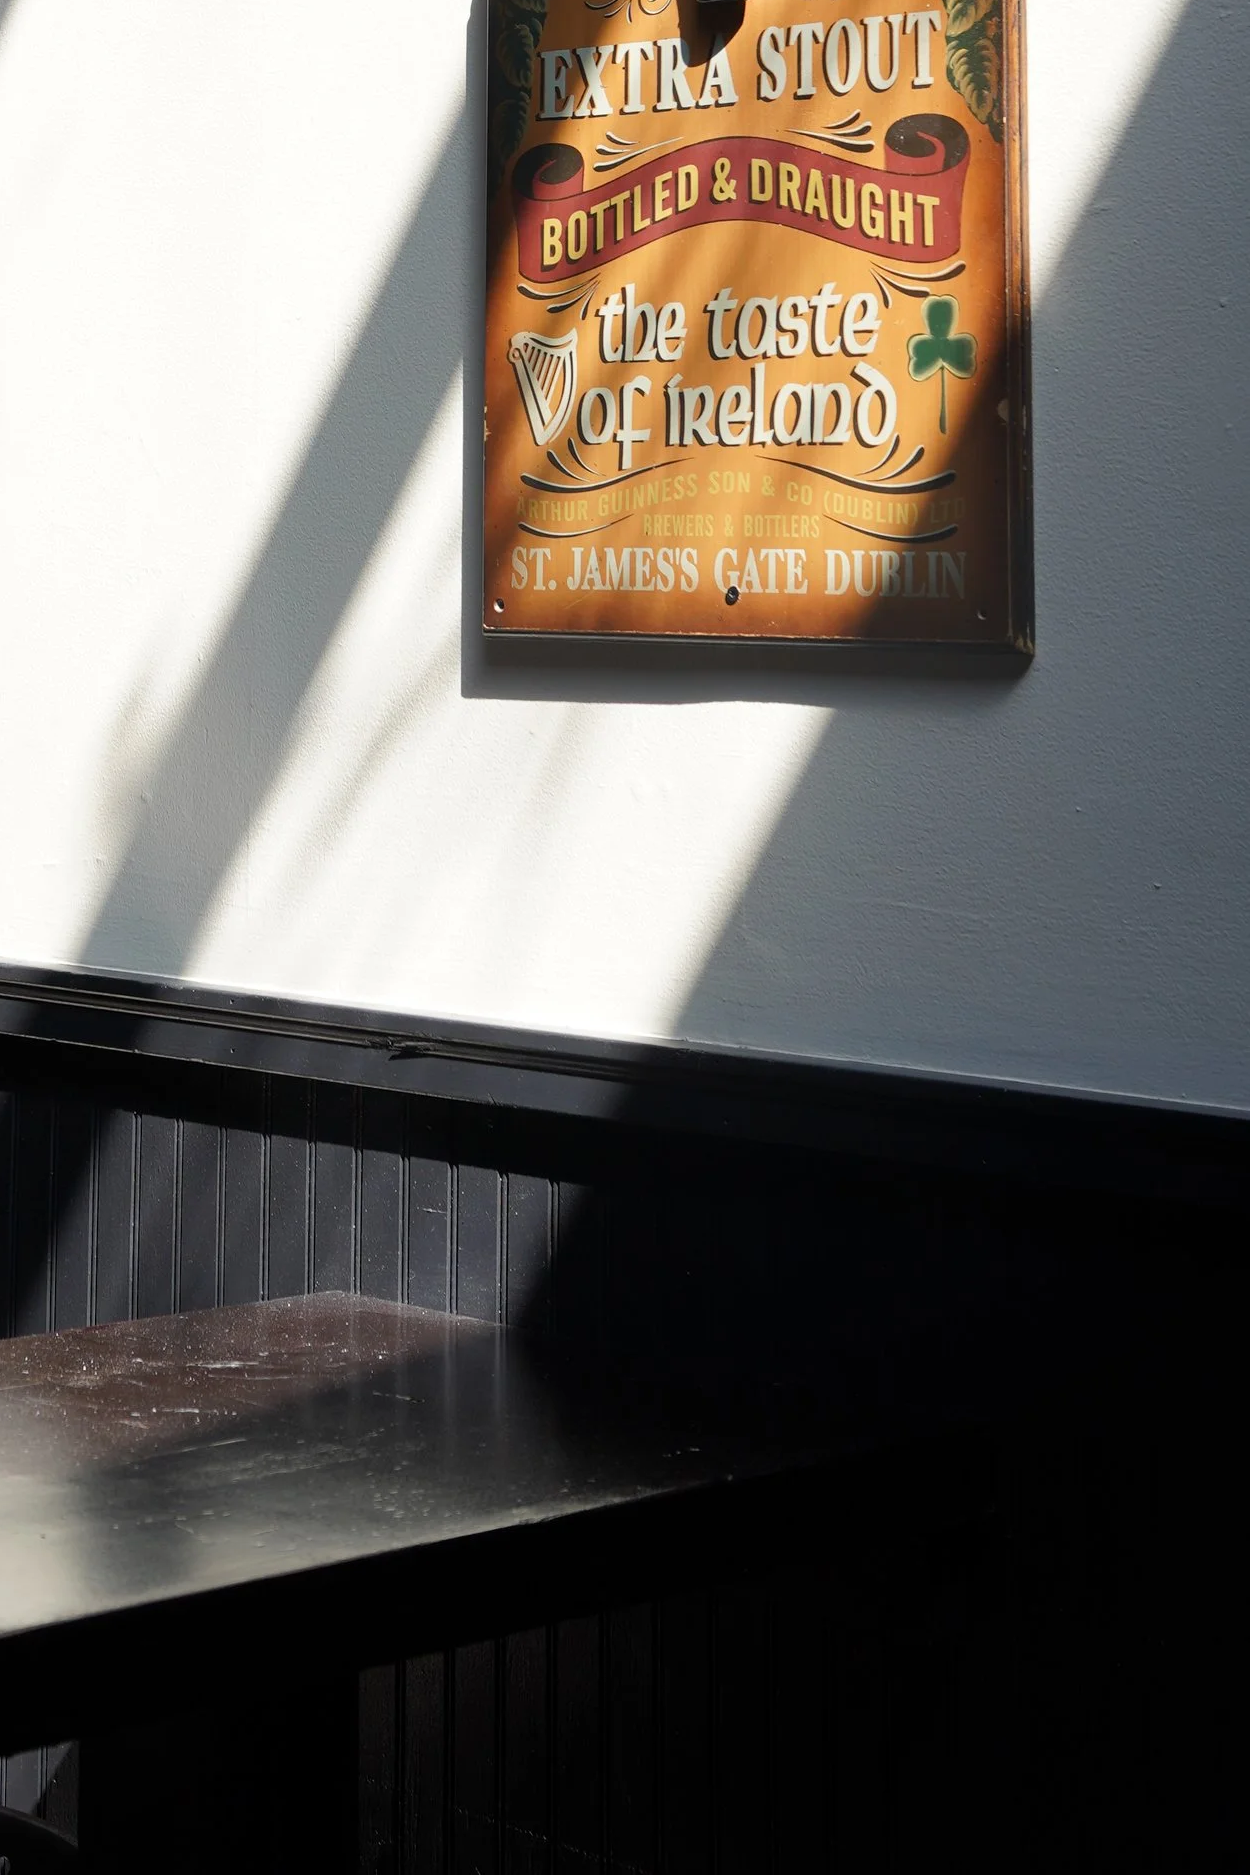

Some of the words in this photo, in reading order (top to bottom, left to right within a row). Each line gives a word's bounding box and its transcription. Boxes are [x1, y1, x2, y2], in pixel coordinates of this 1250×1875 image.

[536, 30, 741, 123] EXTRA
[756, 9, 943, 103] STOUT
[542, 163, 699, 267] BOTTLED
[711, 157, 738, 202] &
[749, 158, 940, 247] DRAUGHT
[598, 282, 688, 363] the
[702, 281, 883, 361] taste
[579, 375, 652, 471] of
[515, 495, 588, 522] ARTHUR
[597, 472, 698, 517] GUINNESS
[708, 471, 752, 496] SON
[761, 476, 776, 497] &
[786, 482, 814, 506] CO
[823, 486, 920, 526] (DUBLIN)
[929, 496, 967, 525] LTD
[643, 513, 715, 538] BREWERS
[724, 514, 735, 537] &
[744, 513, 821, 539] BOTTLERS
[511, 547, 557, 592] ST.
[566, 547, 699, 593] JAMES'S
[714, 547, 809, 595] GATE
[825, 549, 968, 600] DUBLIN
